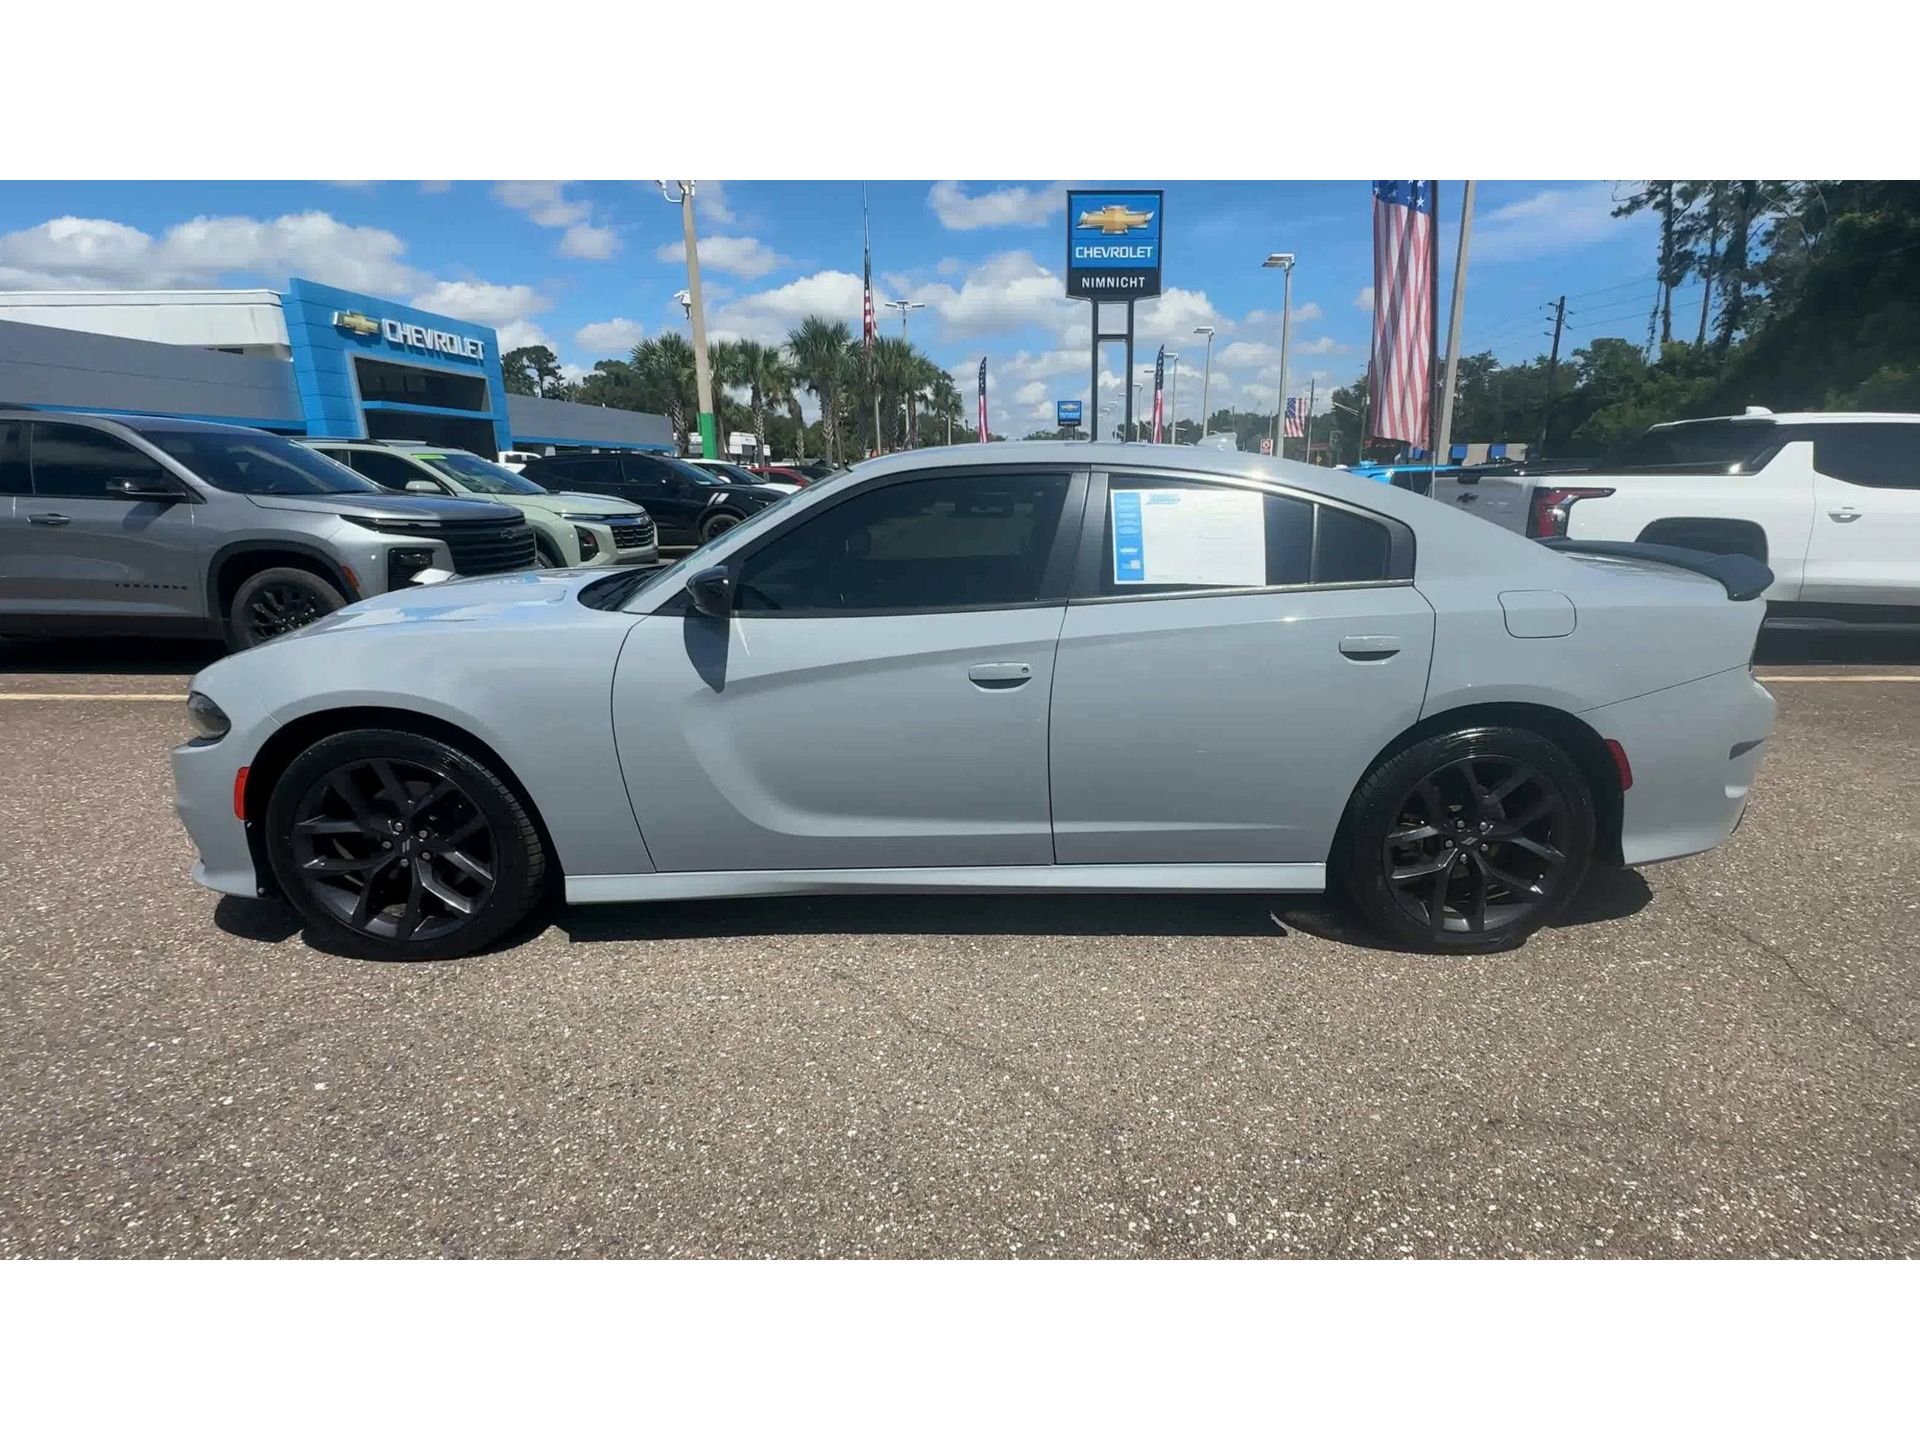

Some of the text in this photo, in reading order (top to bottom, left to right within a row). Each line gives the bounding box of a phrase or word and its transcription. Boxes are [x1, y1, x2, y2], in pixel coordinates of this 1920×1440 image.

[1075, 246, 1153, 258] CHEVROLET
[1082, 276, 1145, 288] NIMNICHT
[381, 318, 484, 359] CHEVROLET
